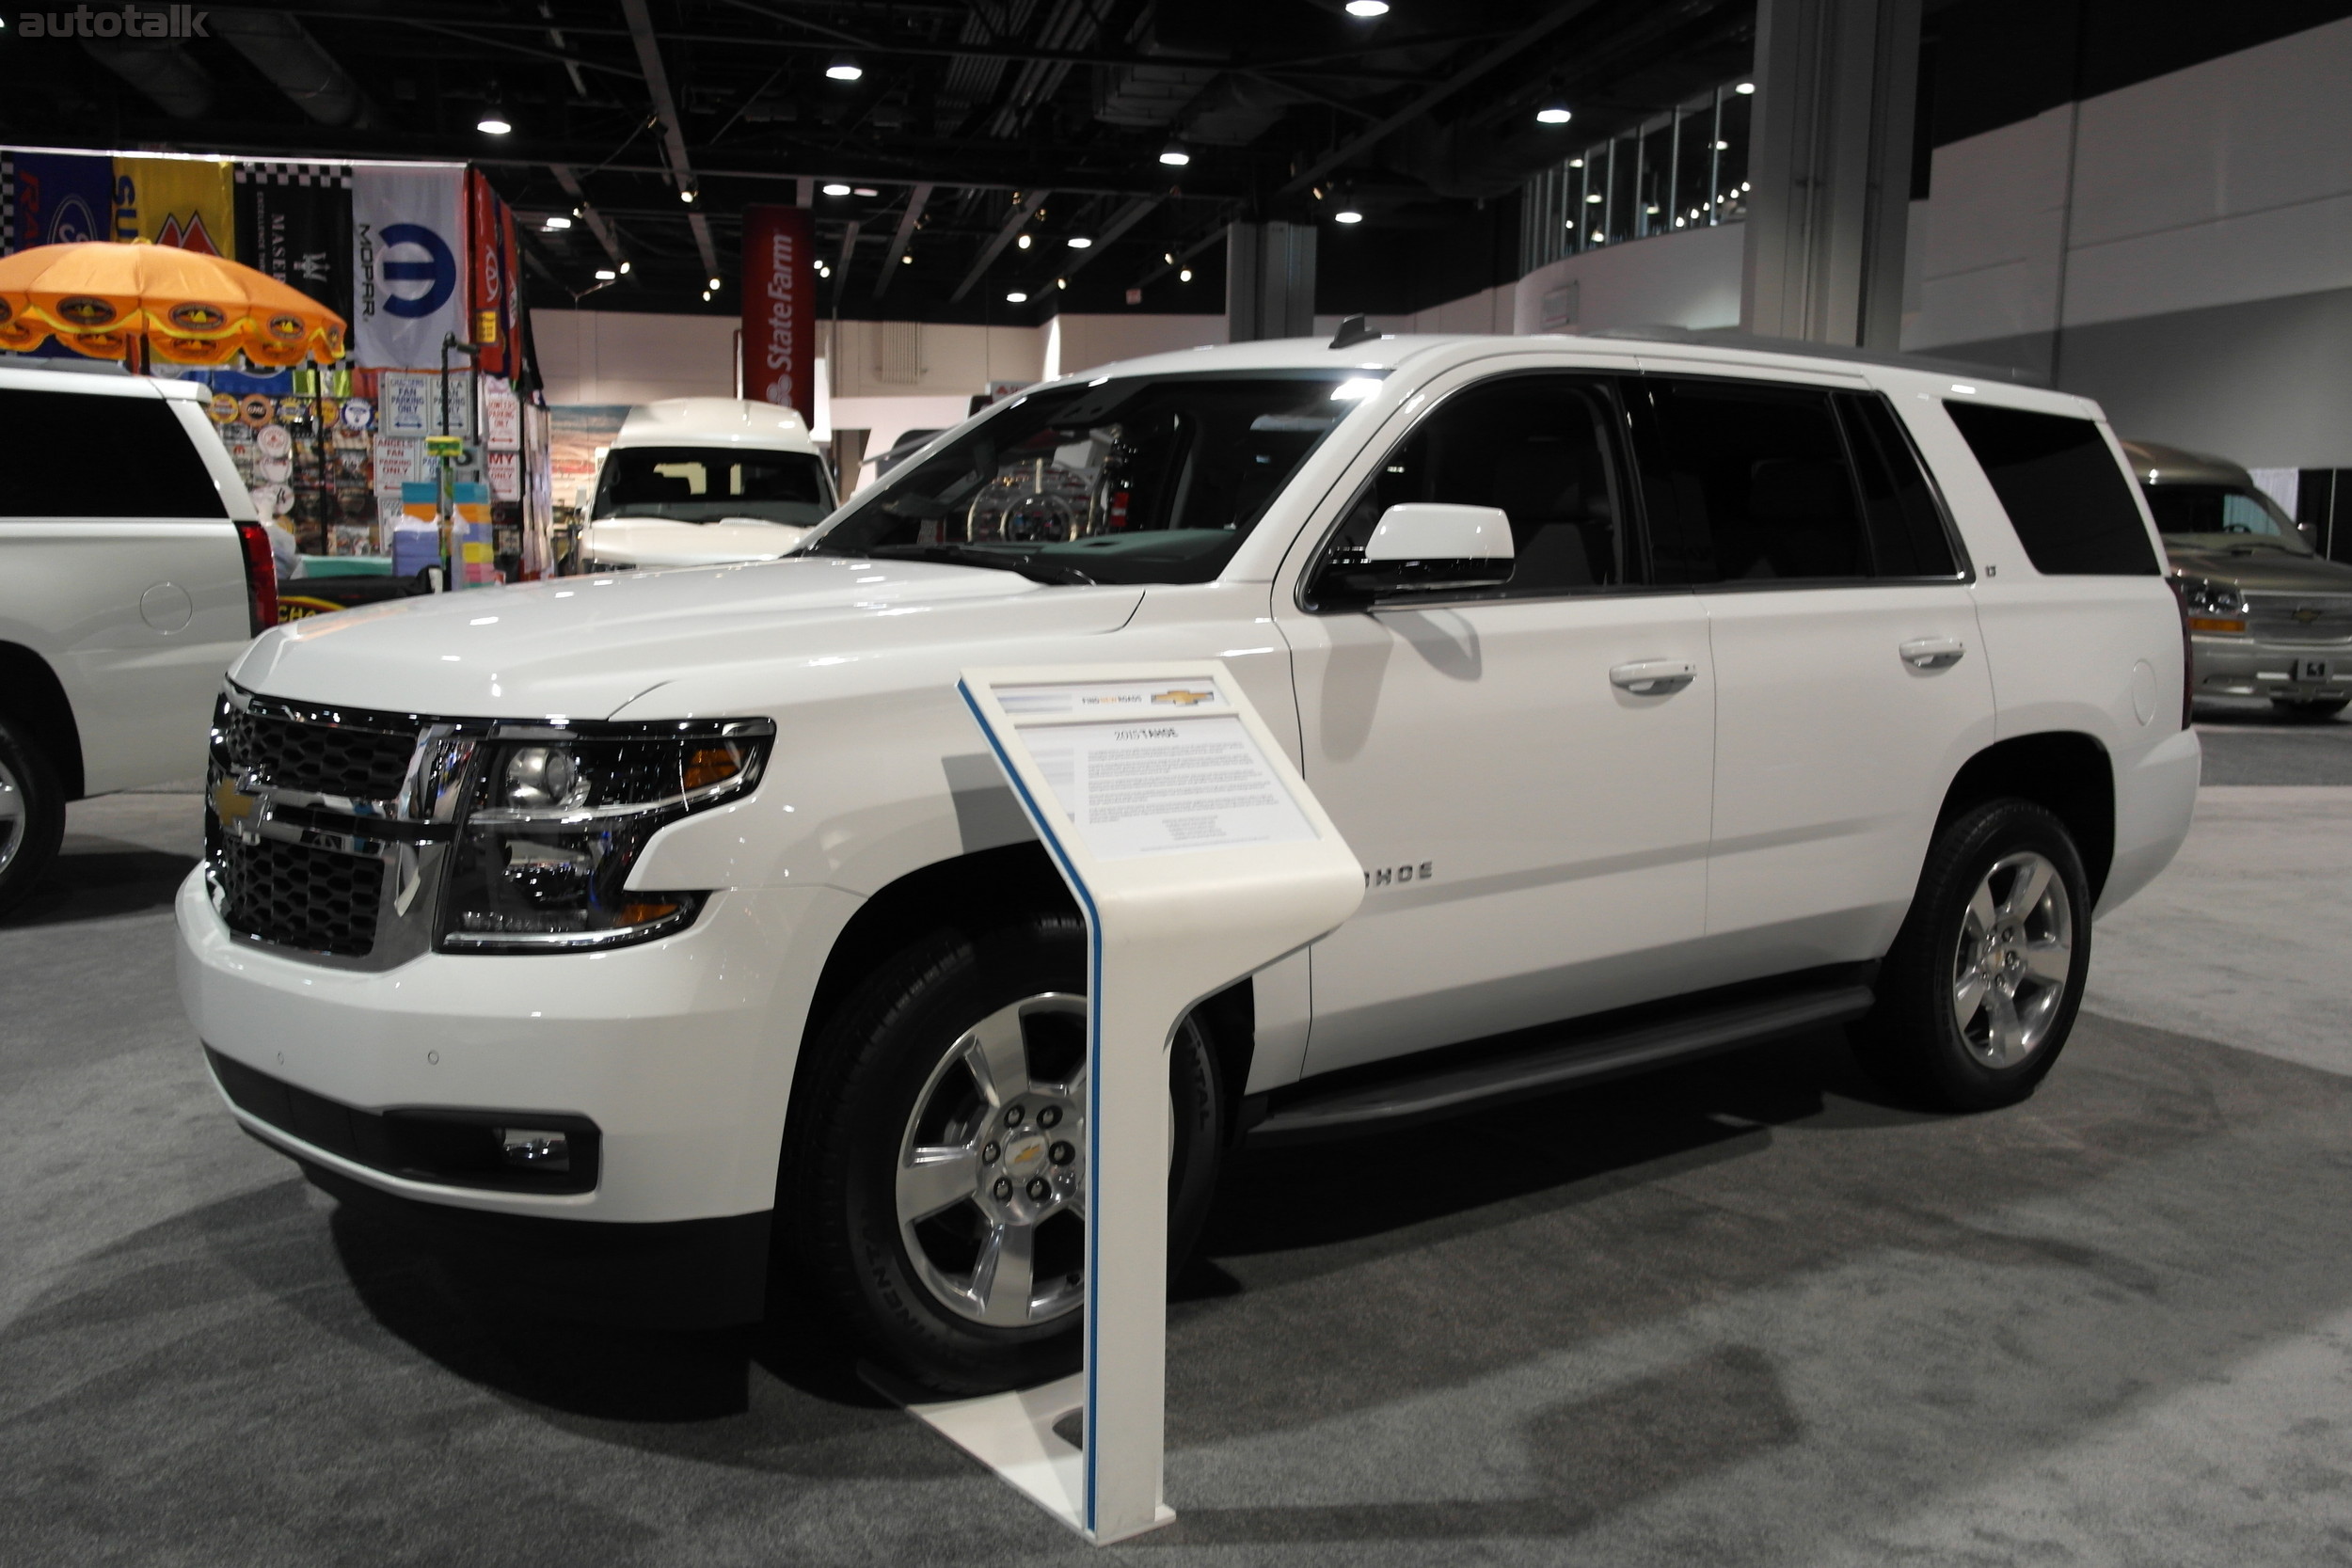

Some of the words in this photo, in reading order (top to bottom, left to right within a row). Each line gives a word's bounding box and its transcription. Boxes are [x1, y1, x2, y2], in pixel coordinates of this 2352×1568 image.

[114, 175, 139, 242] SU
[271, 213, 287, 283] MASER
[359, 223, 375, 317] MOPAR
[398, 388, 417, 396] FAN
[391, 396, 424, 405] PARKING
[434, 397, 466, 406] PAKING
[398, 404, 419, 414] ONLY
[377, 438, 413, 449] ANGELS
[387, 449, 405, 457] FAN
[489, 453, 514, 465] MY
[382, 467, 408, 475] ONLY
[491, 471, 512, 480] ONLY
[1364, 861, 1433, 888] HOE
